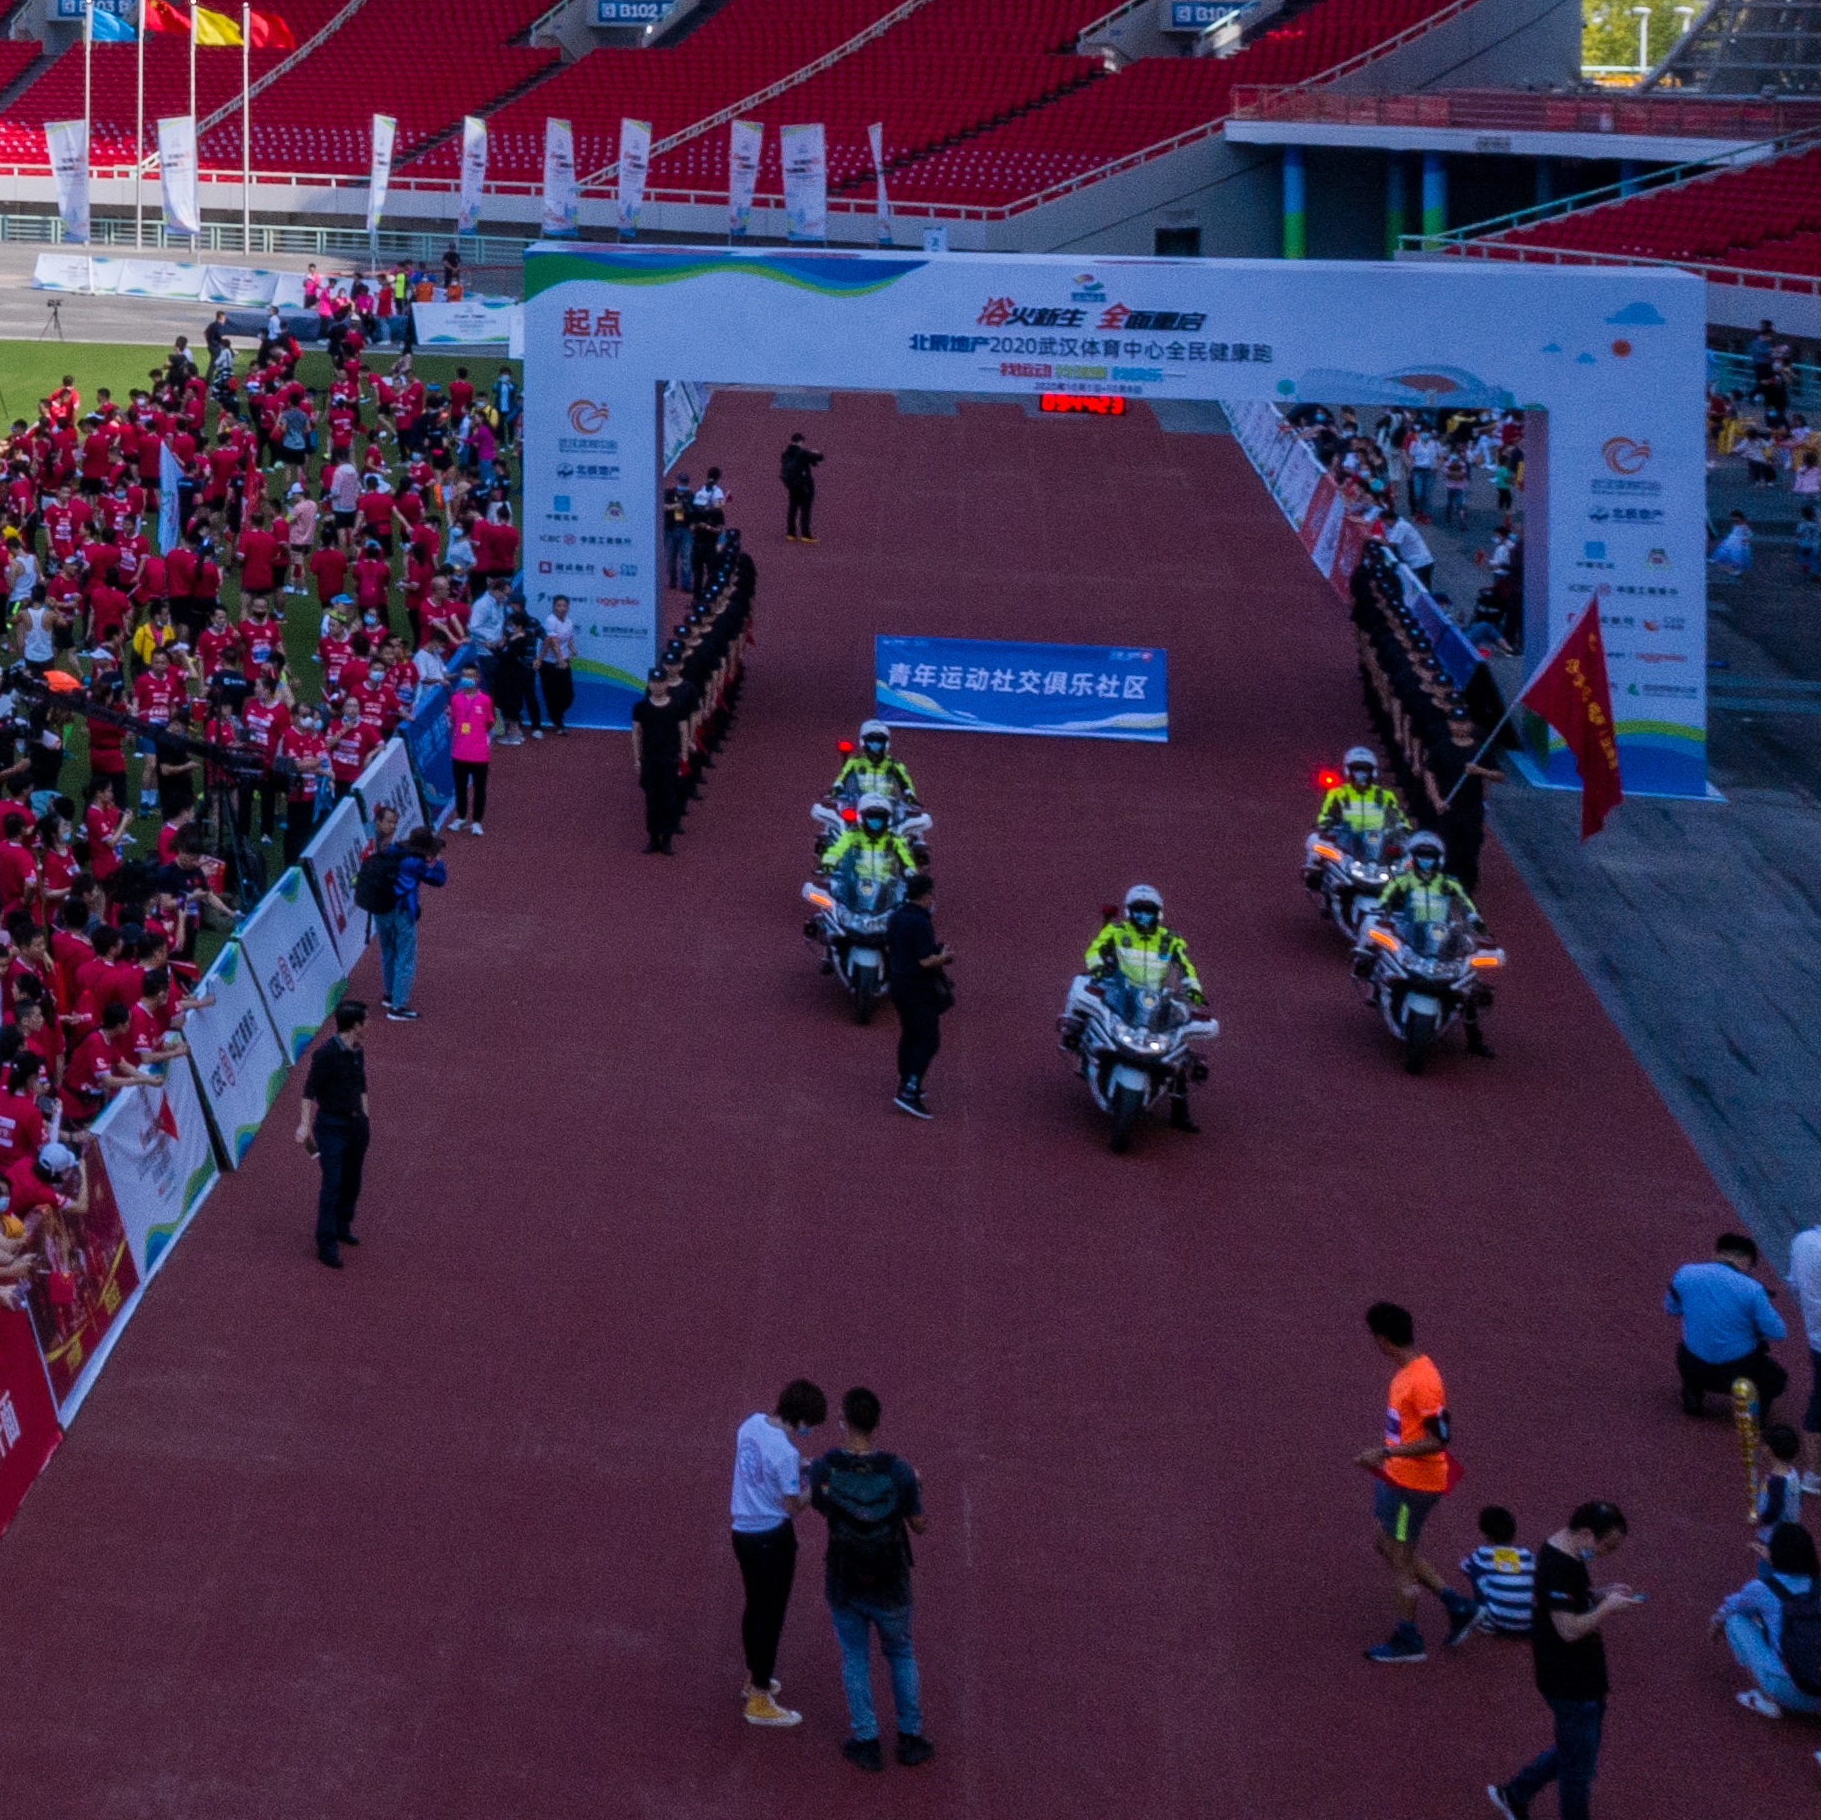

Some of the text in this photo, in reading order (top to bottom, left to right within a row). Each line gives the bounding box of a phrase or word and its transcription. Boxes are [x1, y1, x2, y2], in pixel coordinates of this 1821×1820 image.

[79, 0, 115, 13] B03
[619, 3, 657, 18] B102
[1195, 6, 1233, 21] B10
[562, 307, 622, 337] 起点
[976, 296, 1208, 331] 浴火新生 全面重启
[563, 339, 623, 358] START
[888, 662, 1148, 699] 青年运动社交俱乐社区
